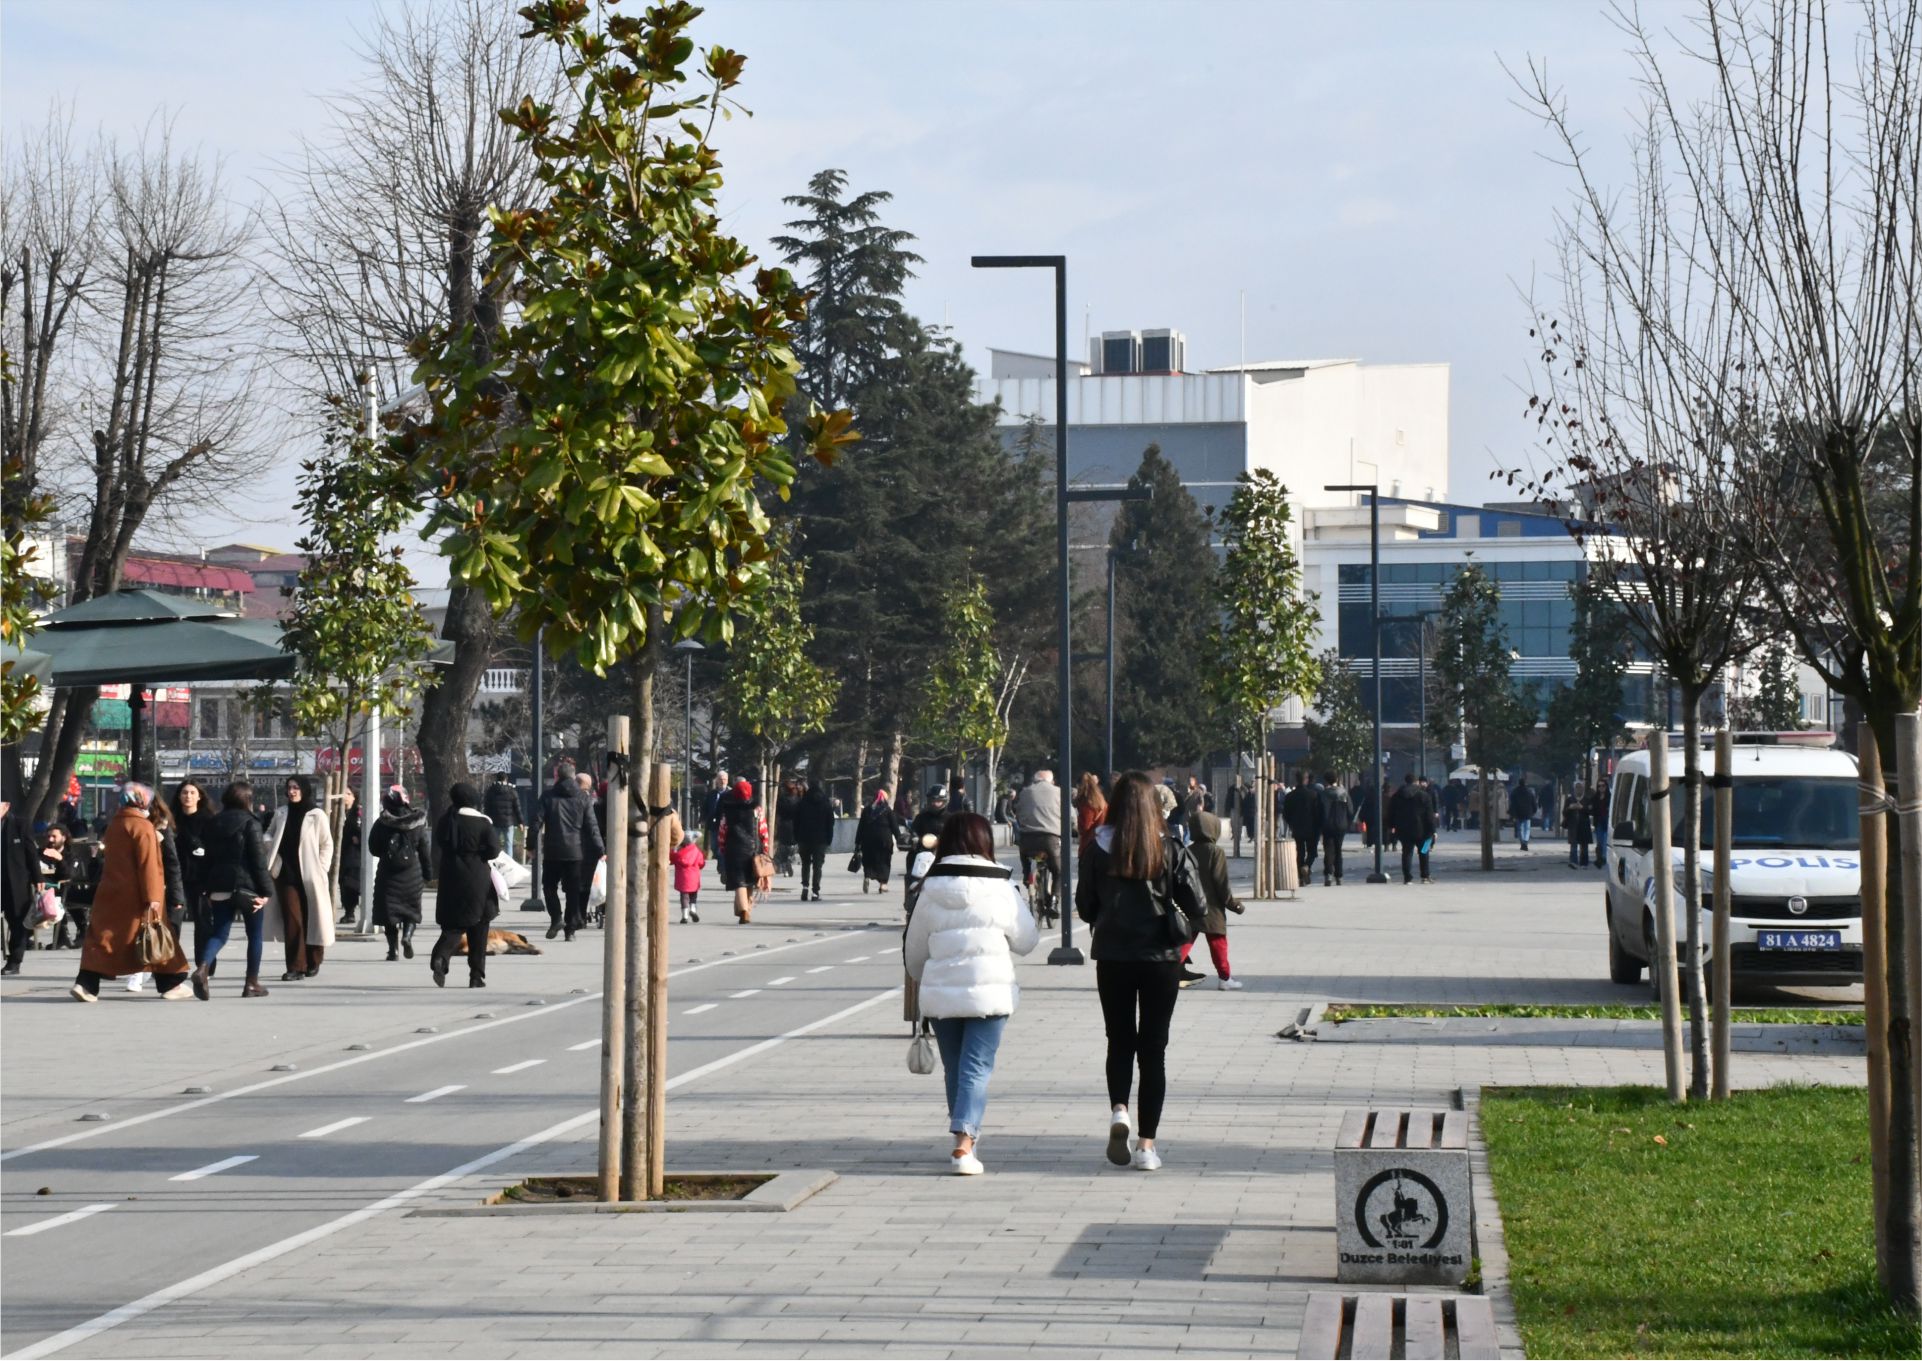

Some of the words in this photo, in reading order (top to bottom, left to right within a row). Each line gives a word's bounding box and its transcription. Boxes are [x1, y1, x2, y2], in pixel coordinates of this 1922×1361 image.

[1730, 855, 1859, 870] POLİS
[1766, 933, 1782, 947] 81
[1786, 933, 1798, 947] A
[1801, 933, 1835, 947] 4824
